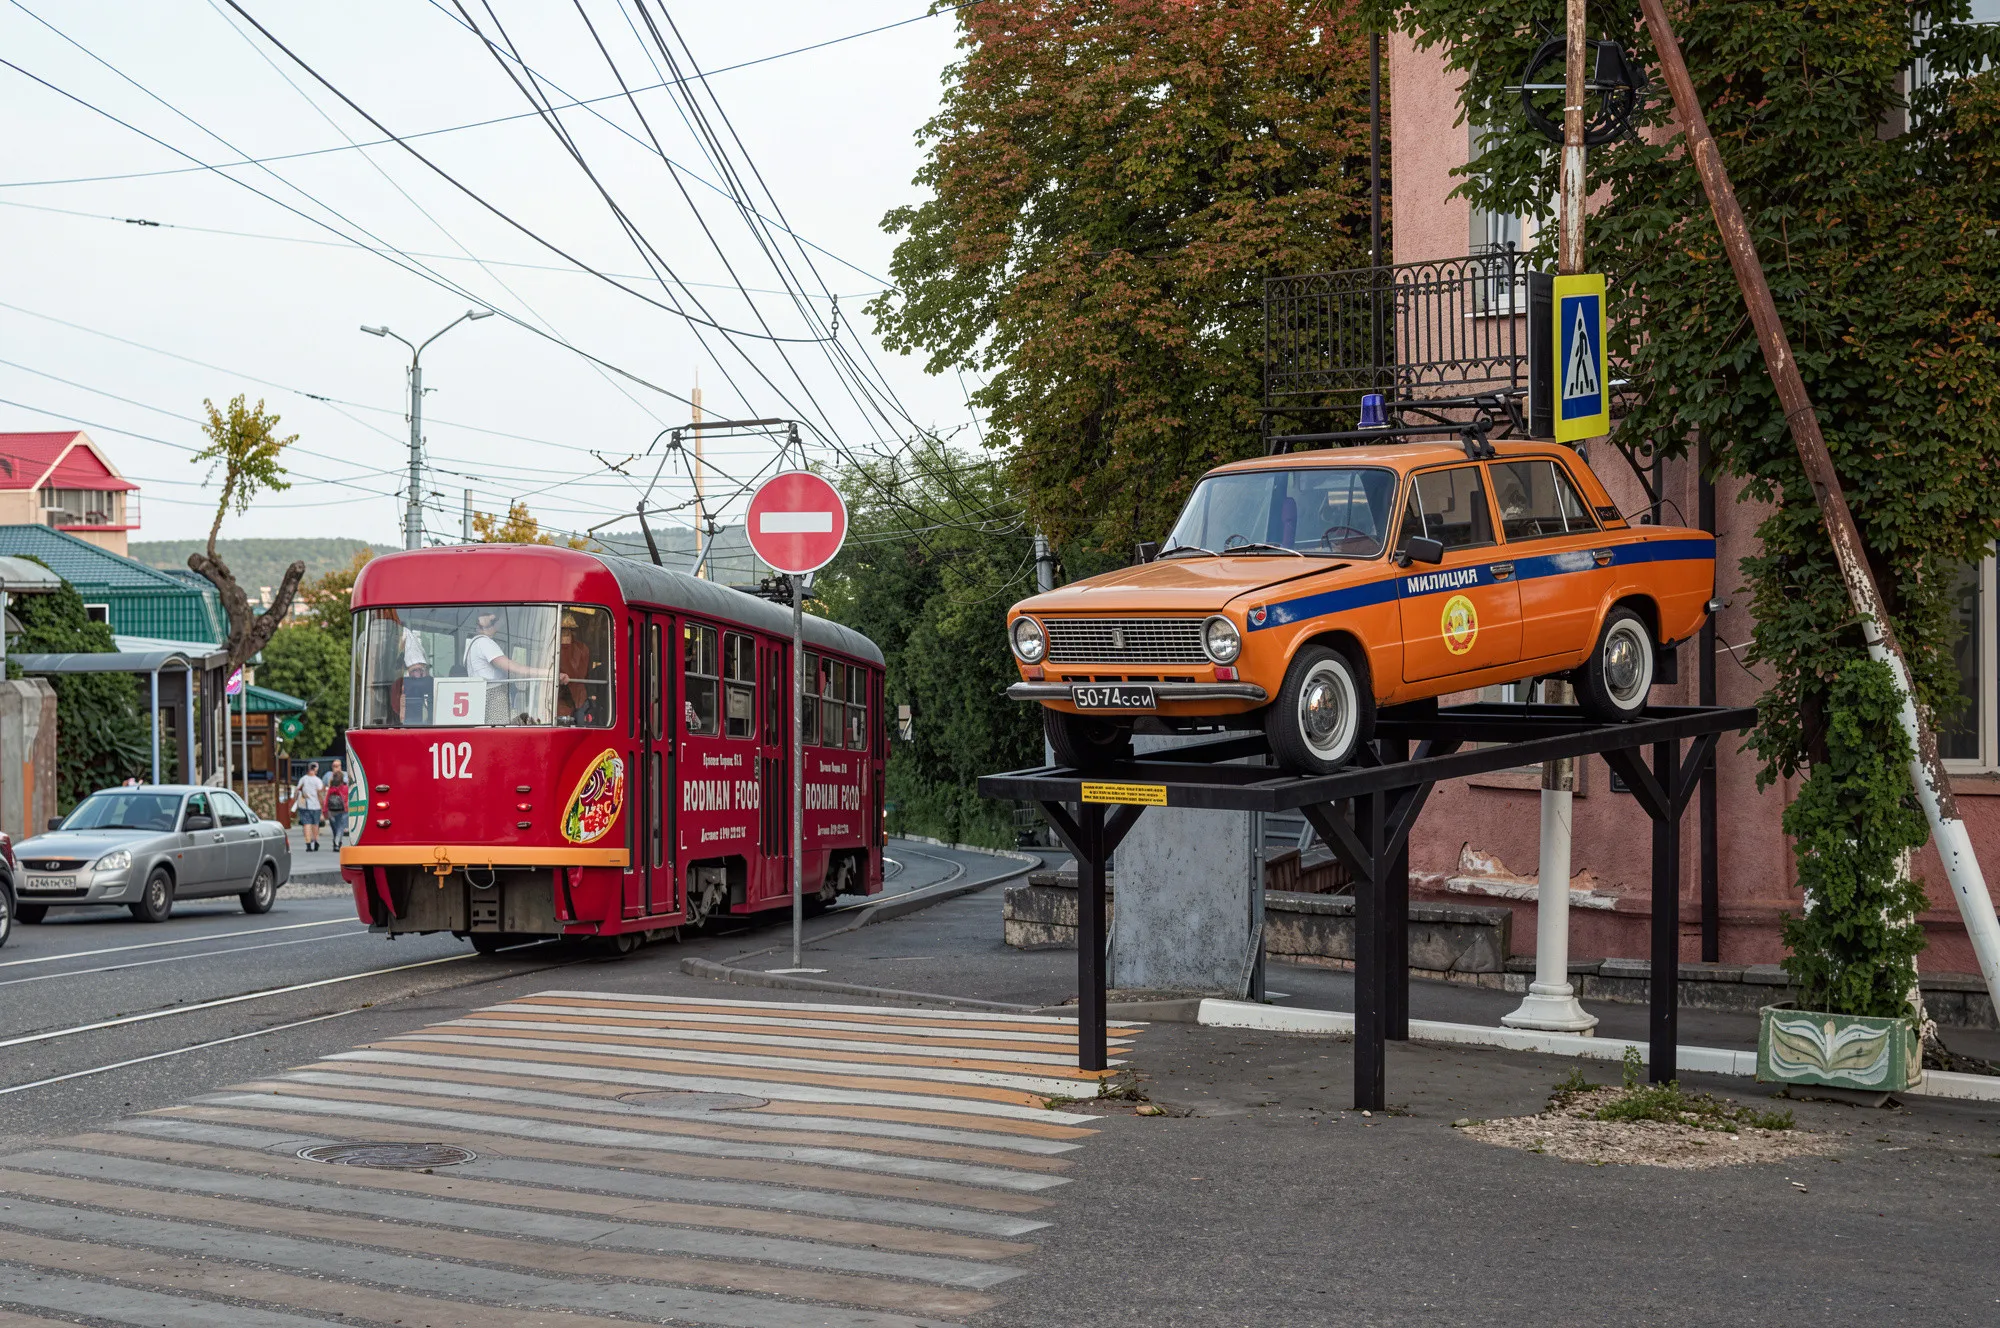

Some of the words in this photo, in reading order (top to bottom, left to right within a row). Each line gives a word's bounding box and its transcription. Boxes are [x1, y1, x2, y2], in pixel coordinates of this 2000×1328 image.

[1407, 568, 1478, 593] МИЛИЦИЯ
[452, 691, 470, 717] 5
[428, 741, 473, 780] 102
[683, 780, 730, 811] RODMAN
[735, 780, 760, 810] FOOD
[805, 783, 838, 810] RODMAN
[841, 785, 860, 811] FOOD
